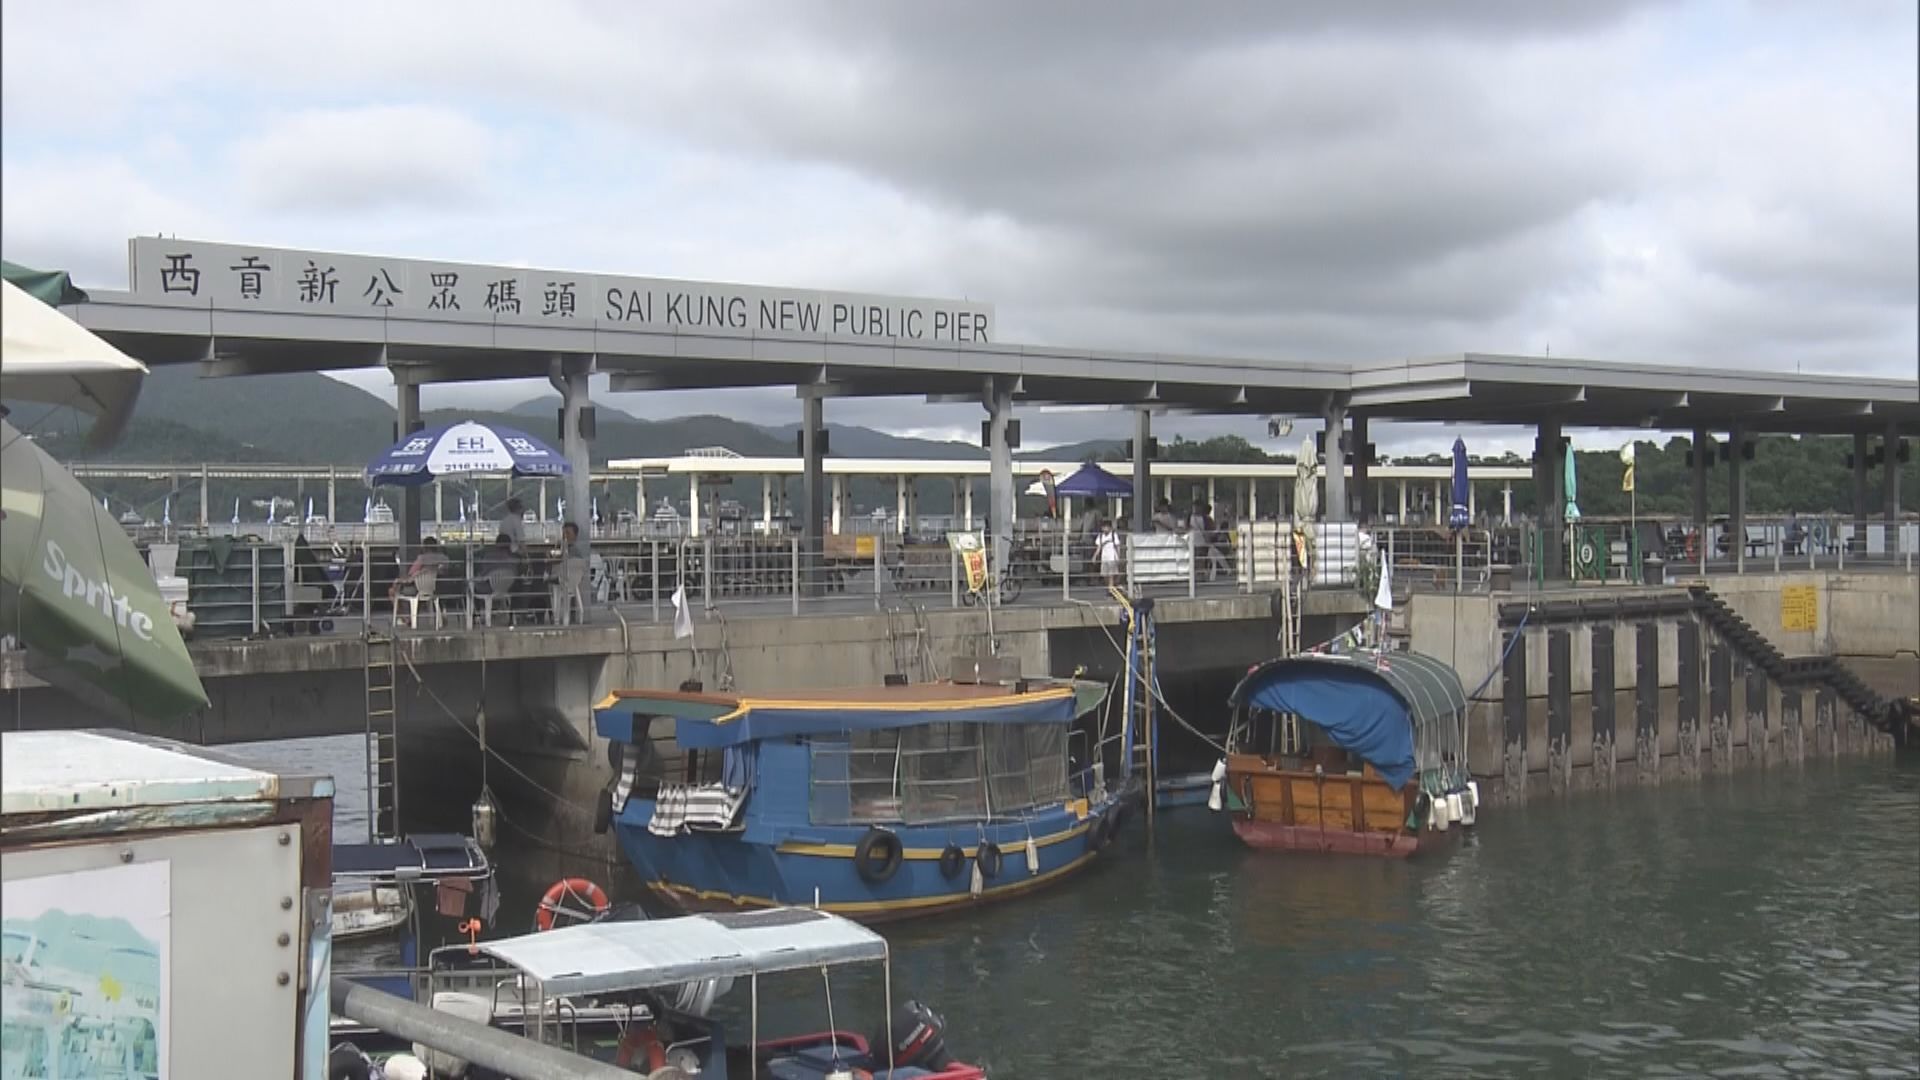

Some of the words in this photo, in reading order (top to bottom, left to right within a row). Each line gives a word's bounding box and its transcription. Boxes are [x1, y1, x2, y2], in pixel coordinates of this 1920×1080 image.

[160, 253, 577, 318] 西貢新公眾碼頭
[606, 288, 652, 322] SAI
[666, 292, 747, 328] KUNG
[760, 299, 821, 332] NEW
[833, 303, 923, 340] PUBLIC
[934, 311, 988, 344] PIER
[43, 539, 153, 641] Sprite
